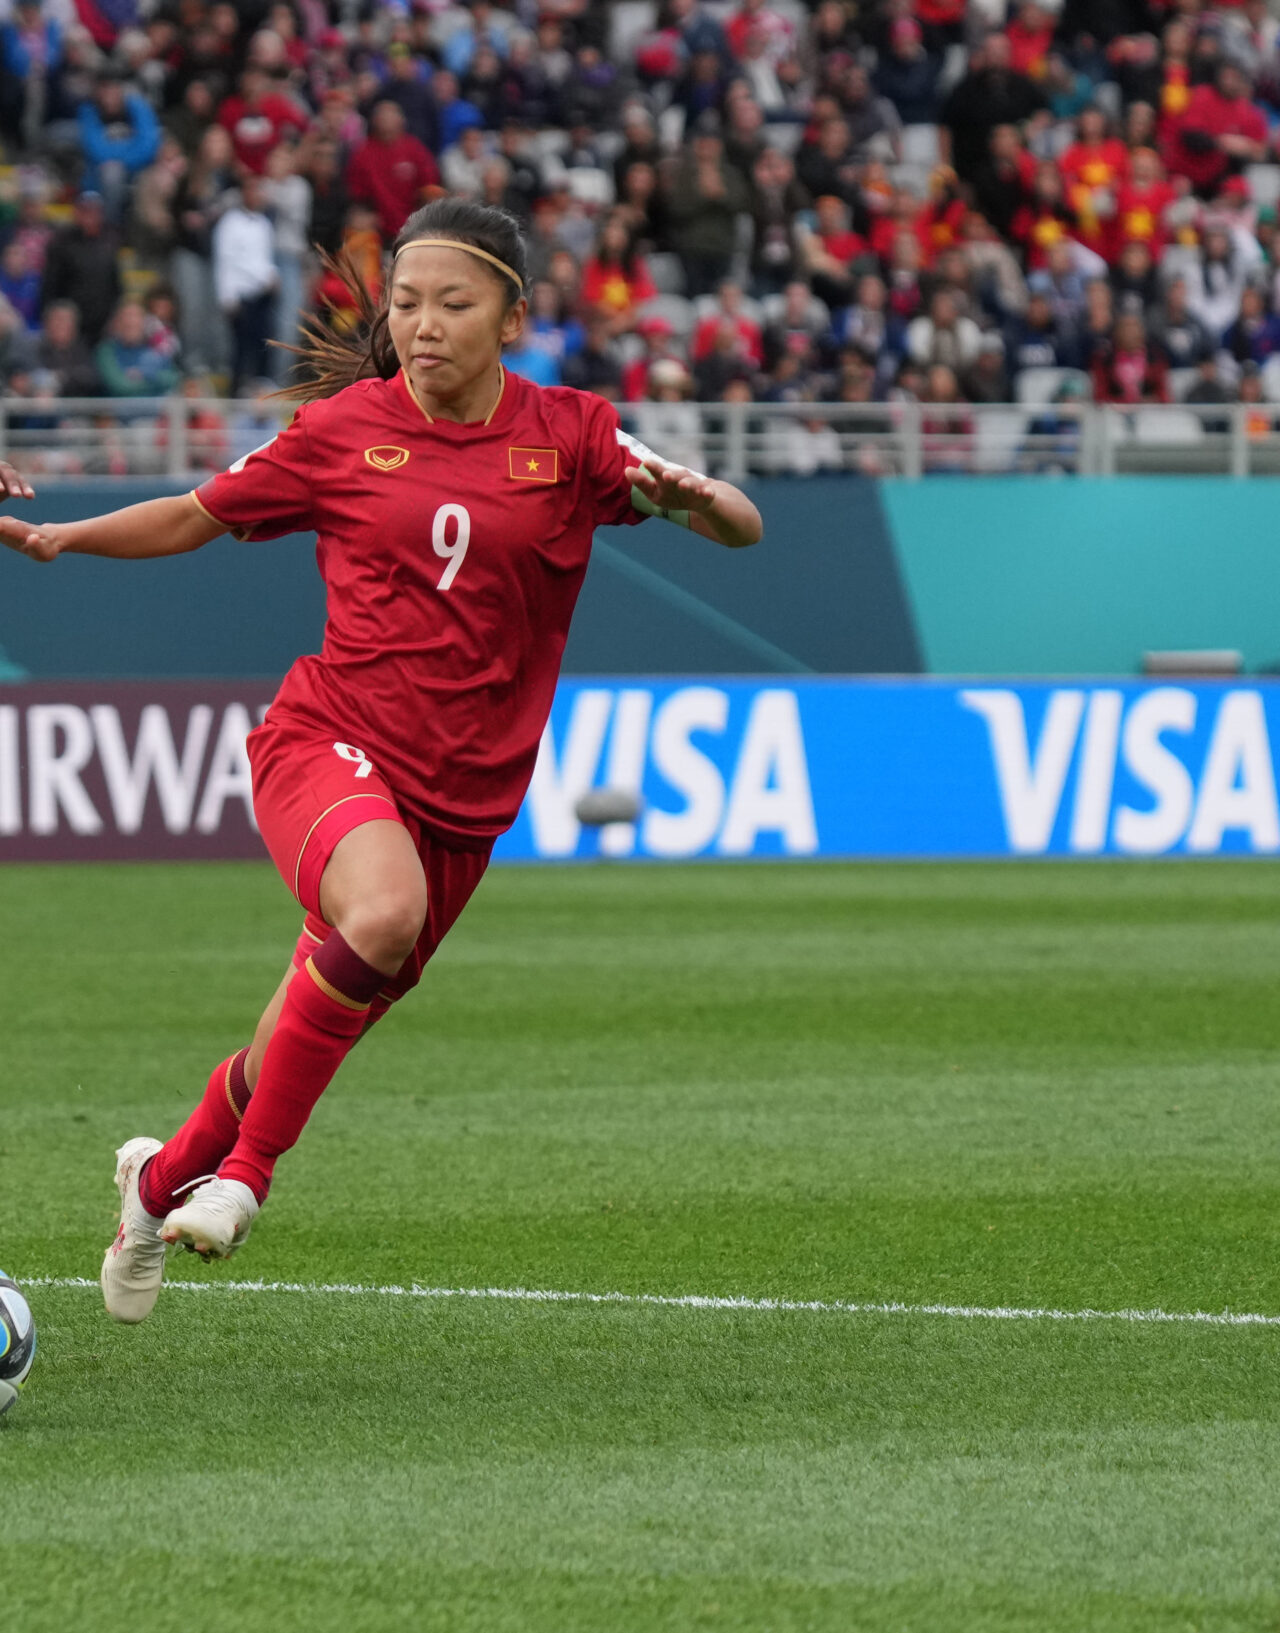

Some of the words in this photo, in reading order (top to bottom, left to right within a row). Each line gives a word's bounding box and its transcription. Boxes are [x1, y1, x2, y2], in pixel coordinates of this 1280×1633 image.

[431, 502, 471, 590] 9
[332, 740, 373, 779] 9
[528, 686, 820, 857] VISA
[957, 687, 1280, 853] VISA
